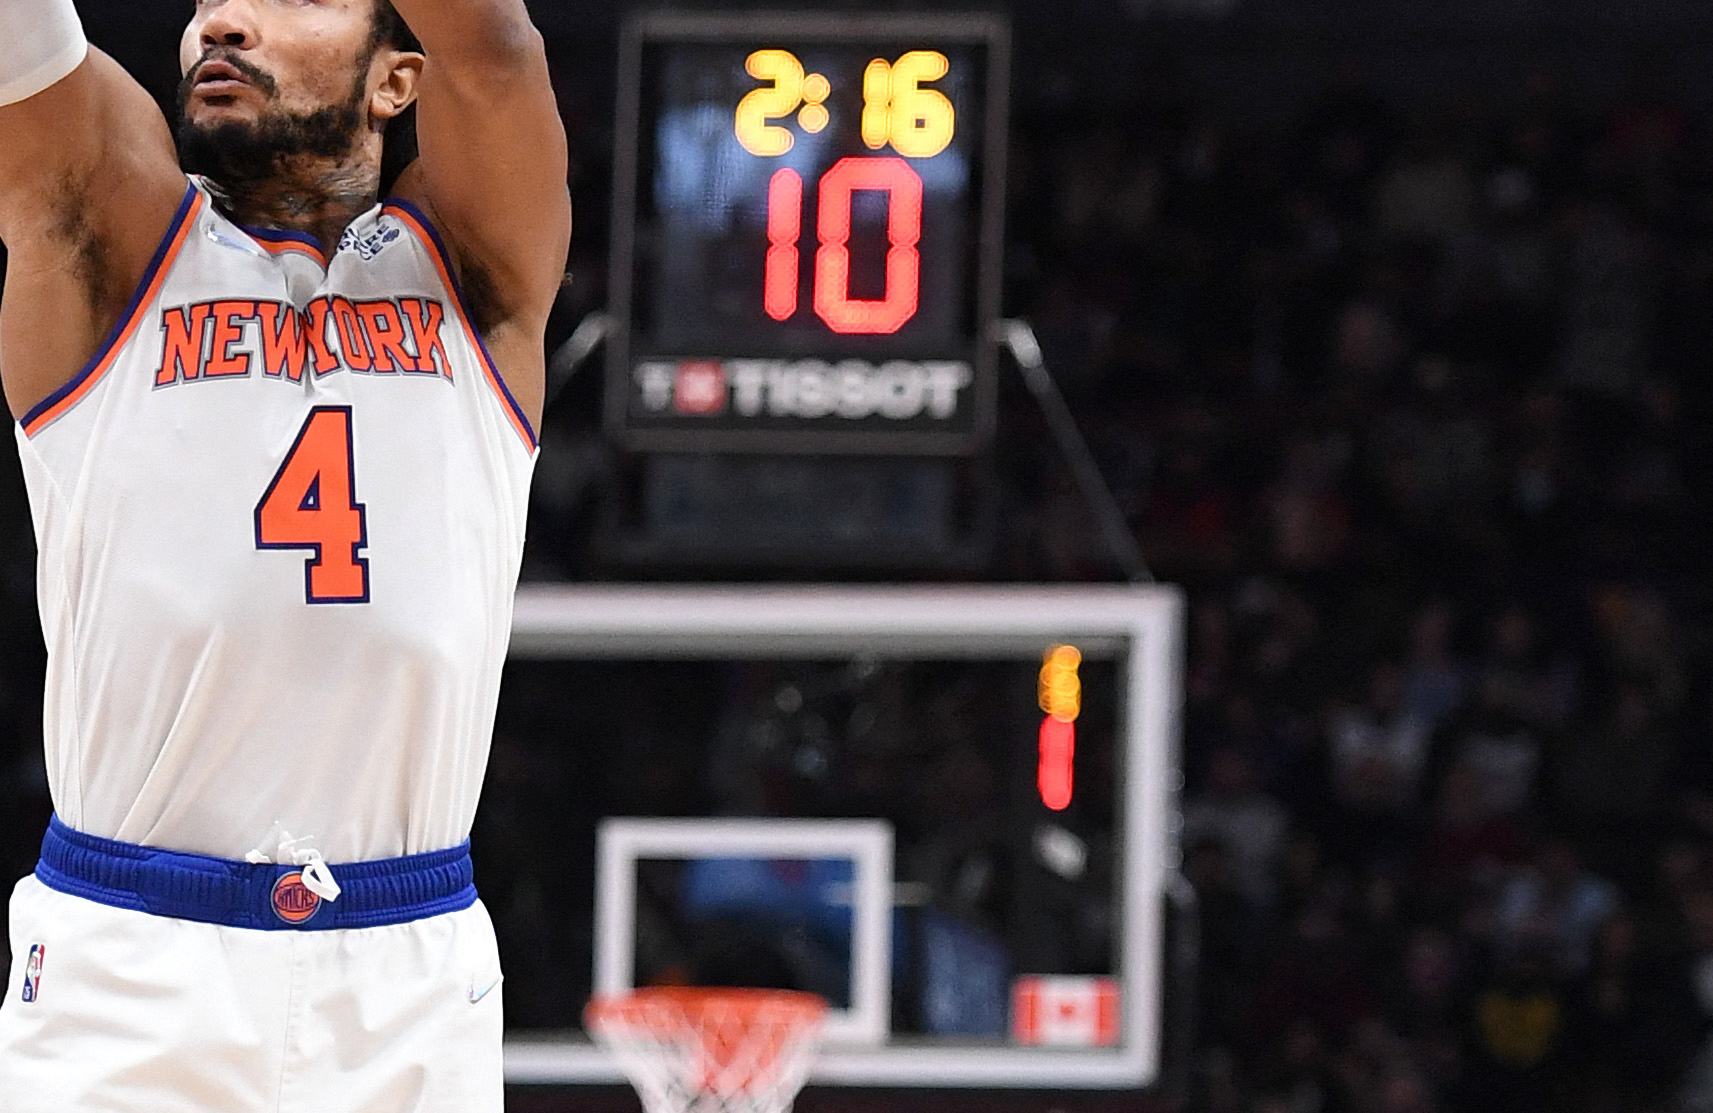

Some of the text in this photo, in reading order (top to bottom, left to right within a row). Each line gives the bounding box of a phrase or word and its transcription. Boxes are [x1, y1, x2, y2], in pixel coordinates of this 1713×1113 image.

[764, 157, 923, 334] 10
[154, 294, 455, 388] NEW YORK
[726, 358, 974, 420] TISSOT
[254, 406, 369, 604] 4
